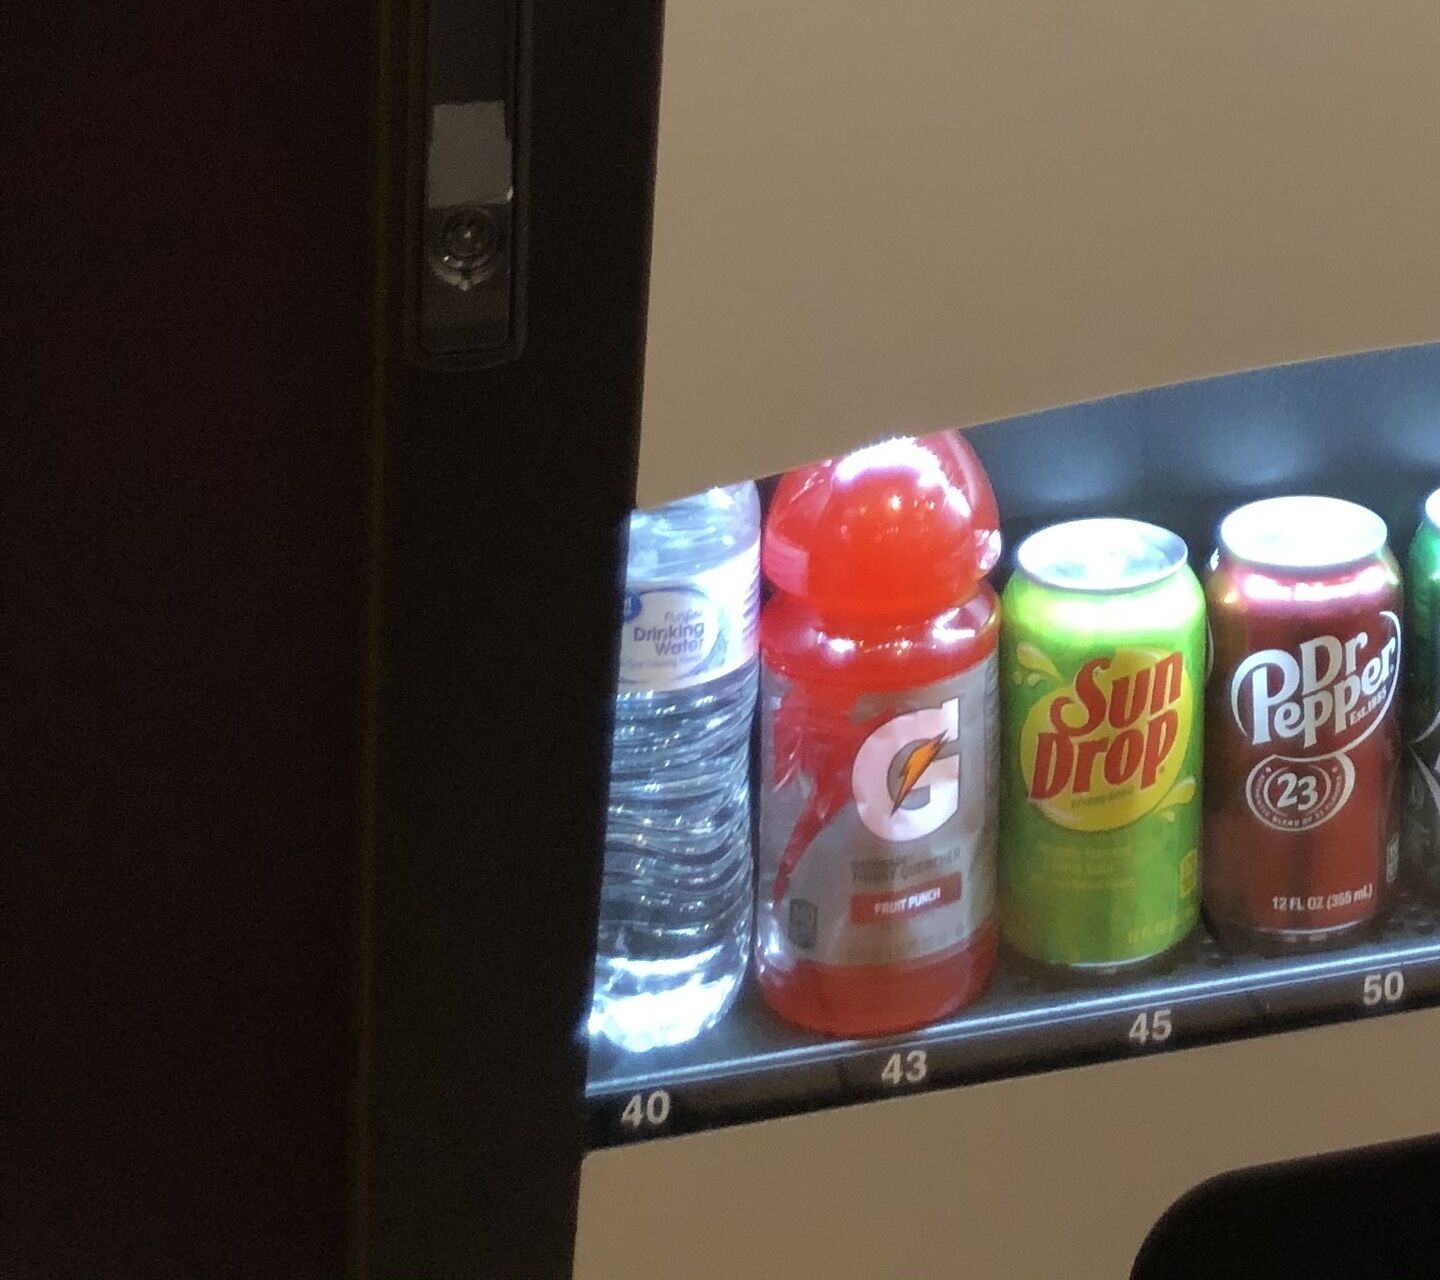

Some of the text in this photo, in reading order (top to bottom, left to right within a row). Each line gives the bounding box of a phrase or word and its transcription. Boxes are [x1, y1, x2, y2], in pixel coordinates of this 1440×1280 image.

[634, 622, 704, 642] Drinking
[1301, 631, 1368, 696] Dr
[1050, 650, 1184, 737] Sun
[1232, 638, 1398, 747] Pepper
[851, 697, 961, 842] G
[1028, 710, 1180, 801] Drop
[1277, 772, 1318, 811] 23
[875, 887, 941, 915] FRUIT PUNCH
[1272, 895, 1288, 910] 12
[1289, 896, 1303, 910] FL
[1307, 896, 1324, 911] OZ
[1362, 970, 1404, 1003] 50
[1128, 1010, 1173, 1044] 45
[881, 1050, 928, 1085] 43
[621, 1090, 671, 1127] 40
